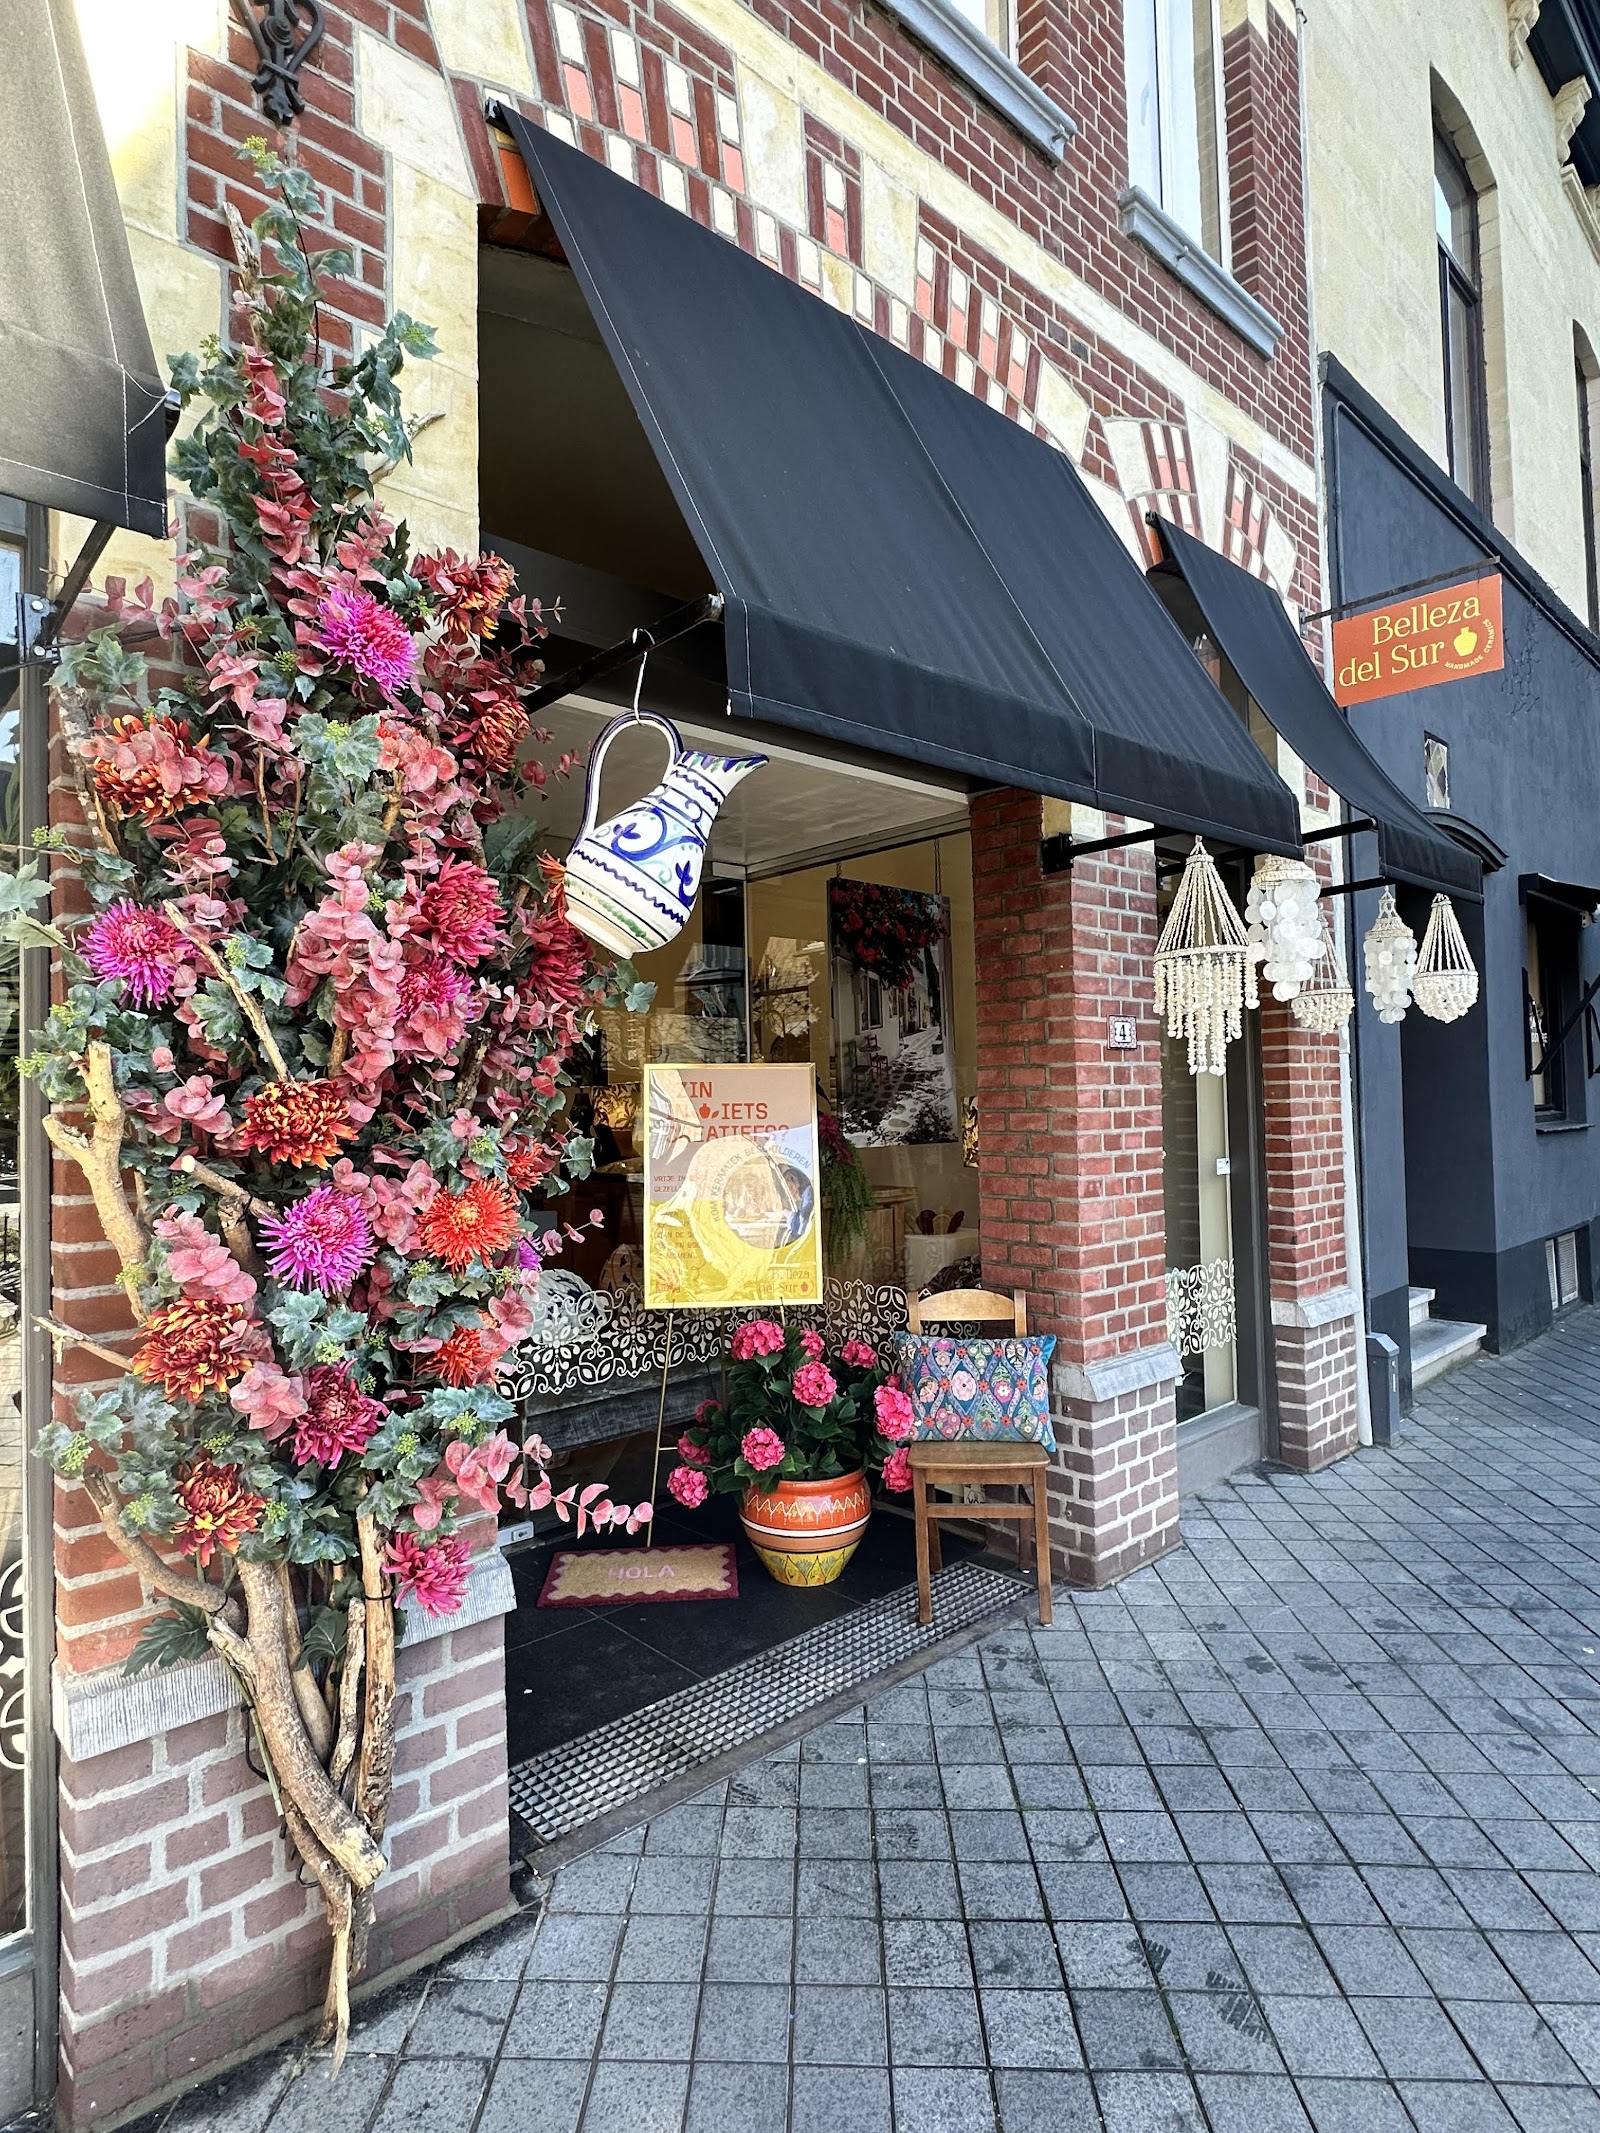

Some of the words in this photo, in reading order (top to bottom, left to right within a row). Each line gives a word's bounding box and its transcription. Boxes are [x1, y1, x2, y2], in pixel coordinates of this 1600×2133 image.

[1372, 596, 1481, 646] Belleza
[1444, 654, 1484, 670] HANDMADE
[1482, 618, 1495, 654] CERAMICS
[1338, 651, 1382, 687] del
[1391, 641, 1445, 674] Sur
[1119, 1024, 1127, 1041] 4
[721, 1103, 768, 1120] IETS
[608, 1565, 675, 1580] HOLA
